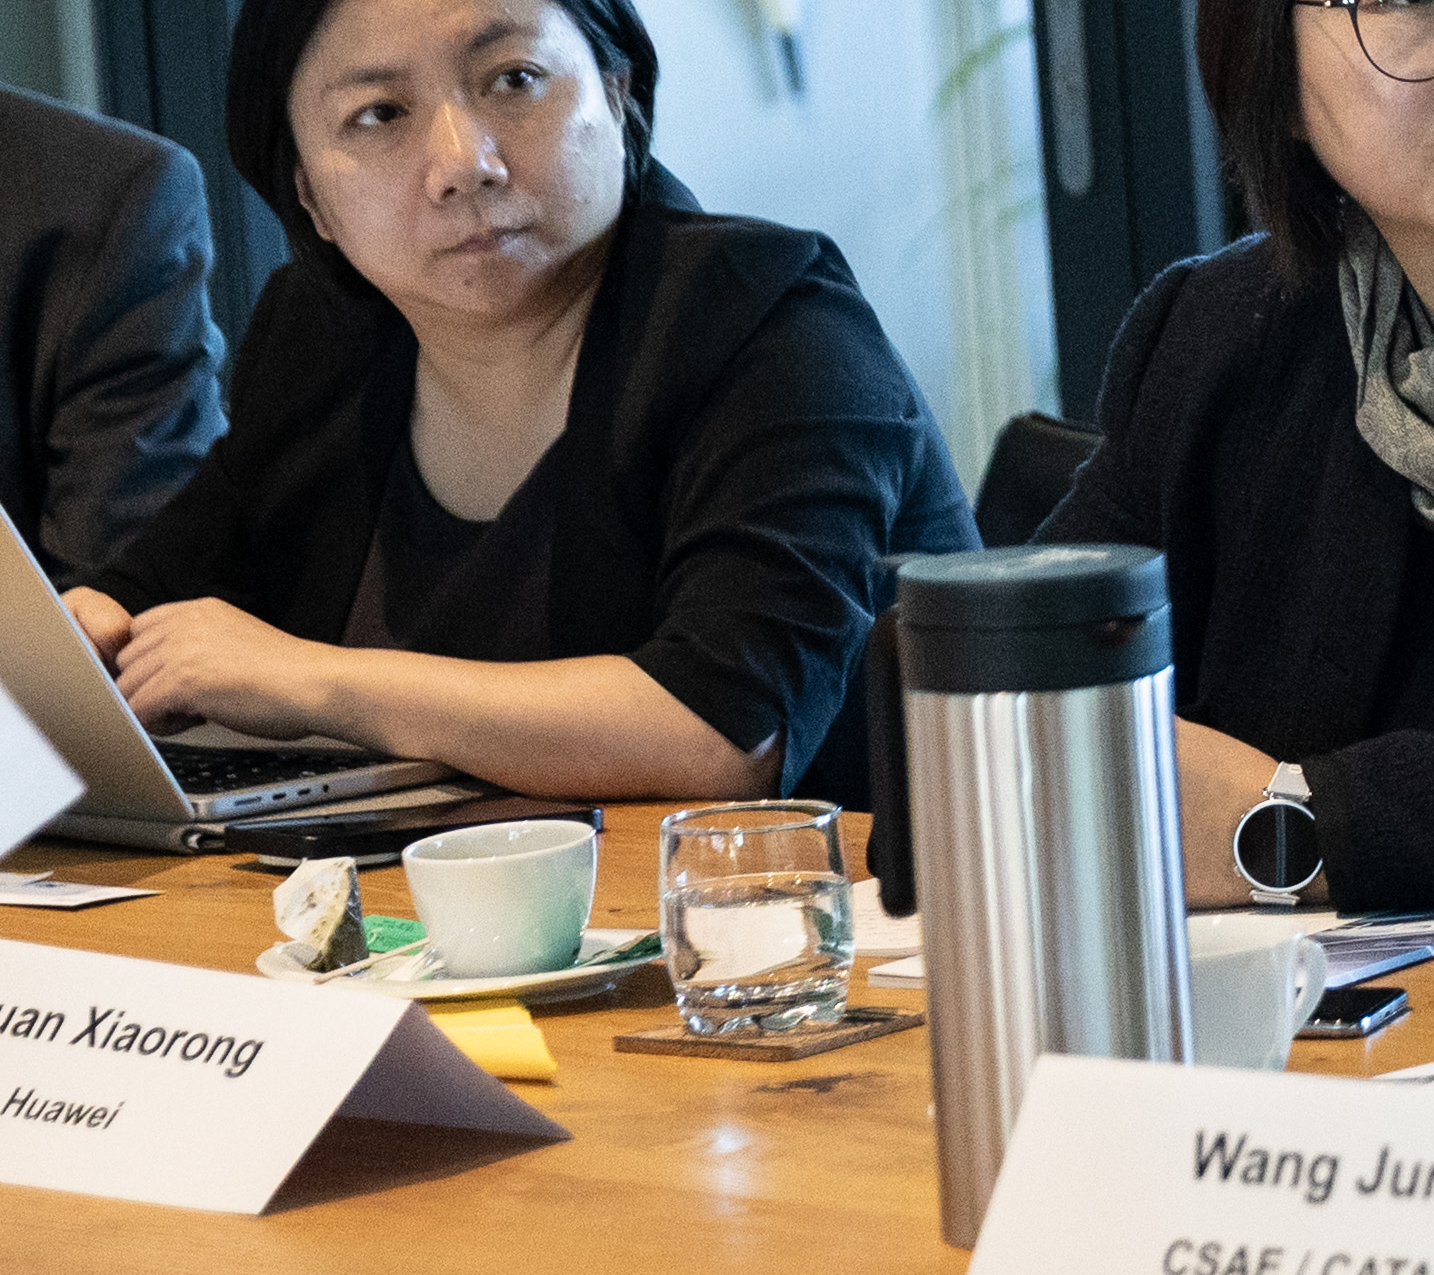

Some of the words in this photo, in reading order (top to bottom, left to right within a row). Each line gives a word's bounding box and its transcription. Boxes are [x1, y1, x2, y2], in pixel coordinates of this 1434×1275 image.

[68, 1005, 265, 1079] Xiaorong
[0, 1086, 125, 1130] Huawei
[1192, 1128, 1340, 1206] Wang
